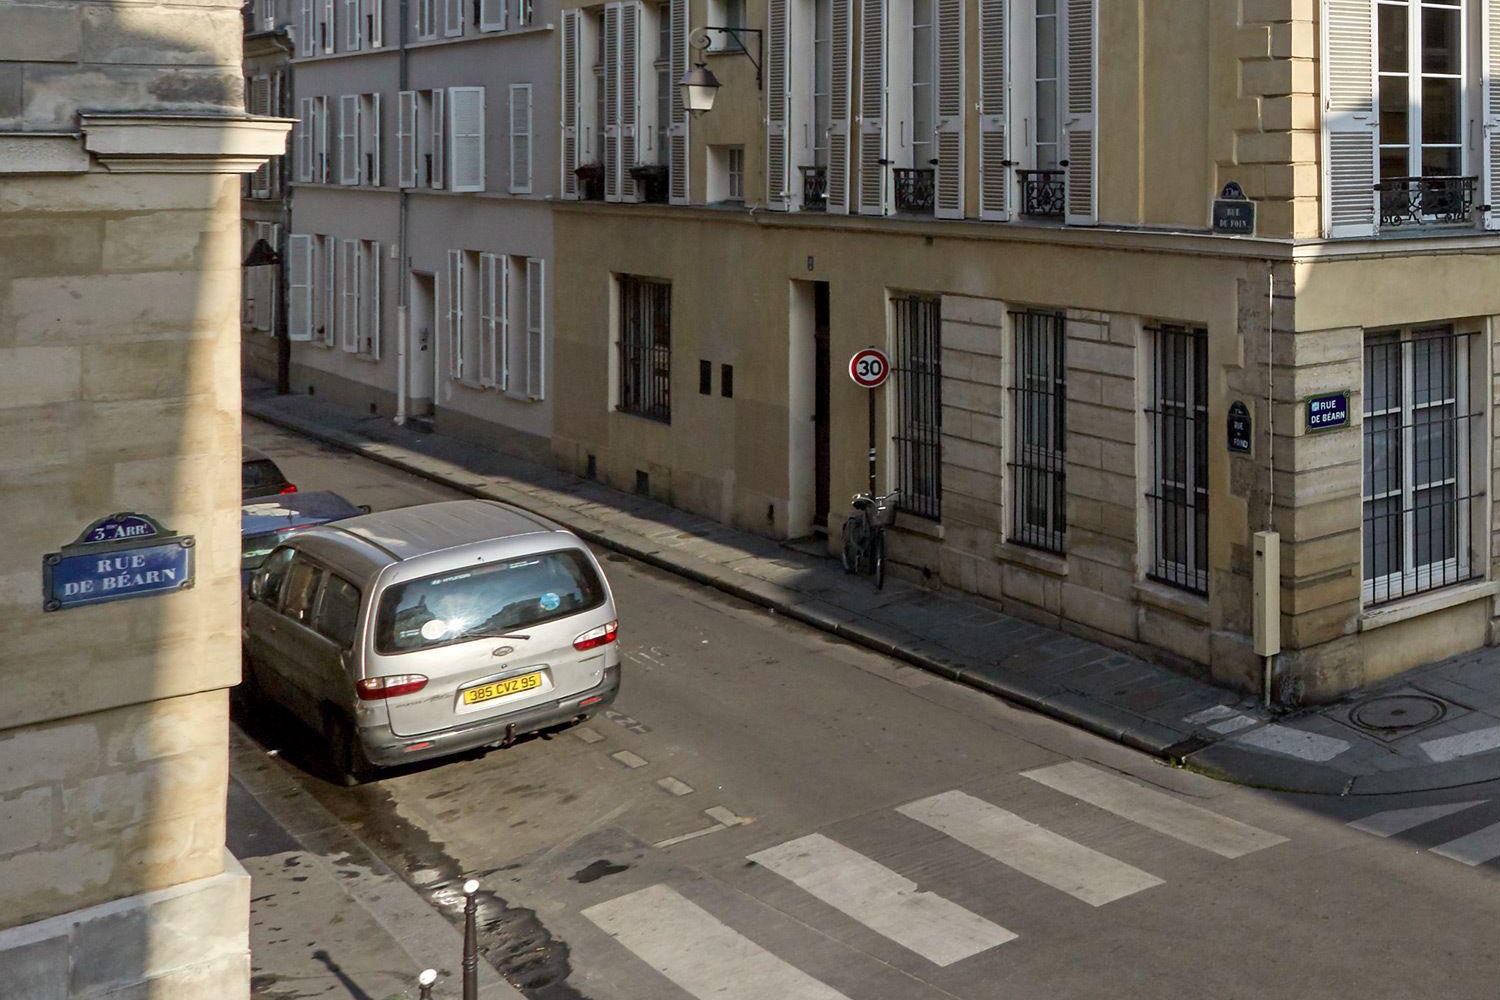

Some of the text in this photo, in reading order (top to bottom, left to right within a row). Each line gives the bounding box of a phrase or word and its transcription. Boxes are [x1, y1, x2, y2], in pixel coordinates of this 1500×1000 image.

[859, 360, 882, 376] 30
[1320, 400, 1337, 410] RUE
[1311, 411, 1345, 424] DE BÉARN
[97, 555, 146, 573] RUE
[64, 568, 176, 596] DE BÉARN
[470, 686, 493, 701] 385
[496, 681, 518, 695] CVZ
[521, 675, 536, 688] 95
